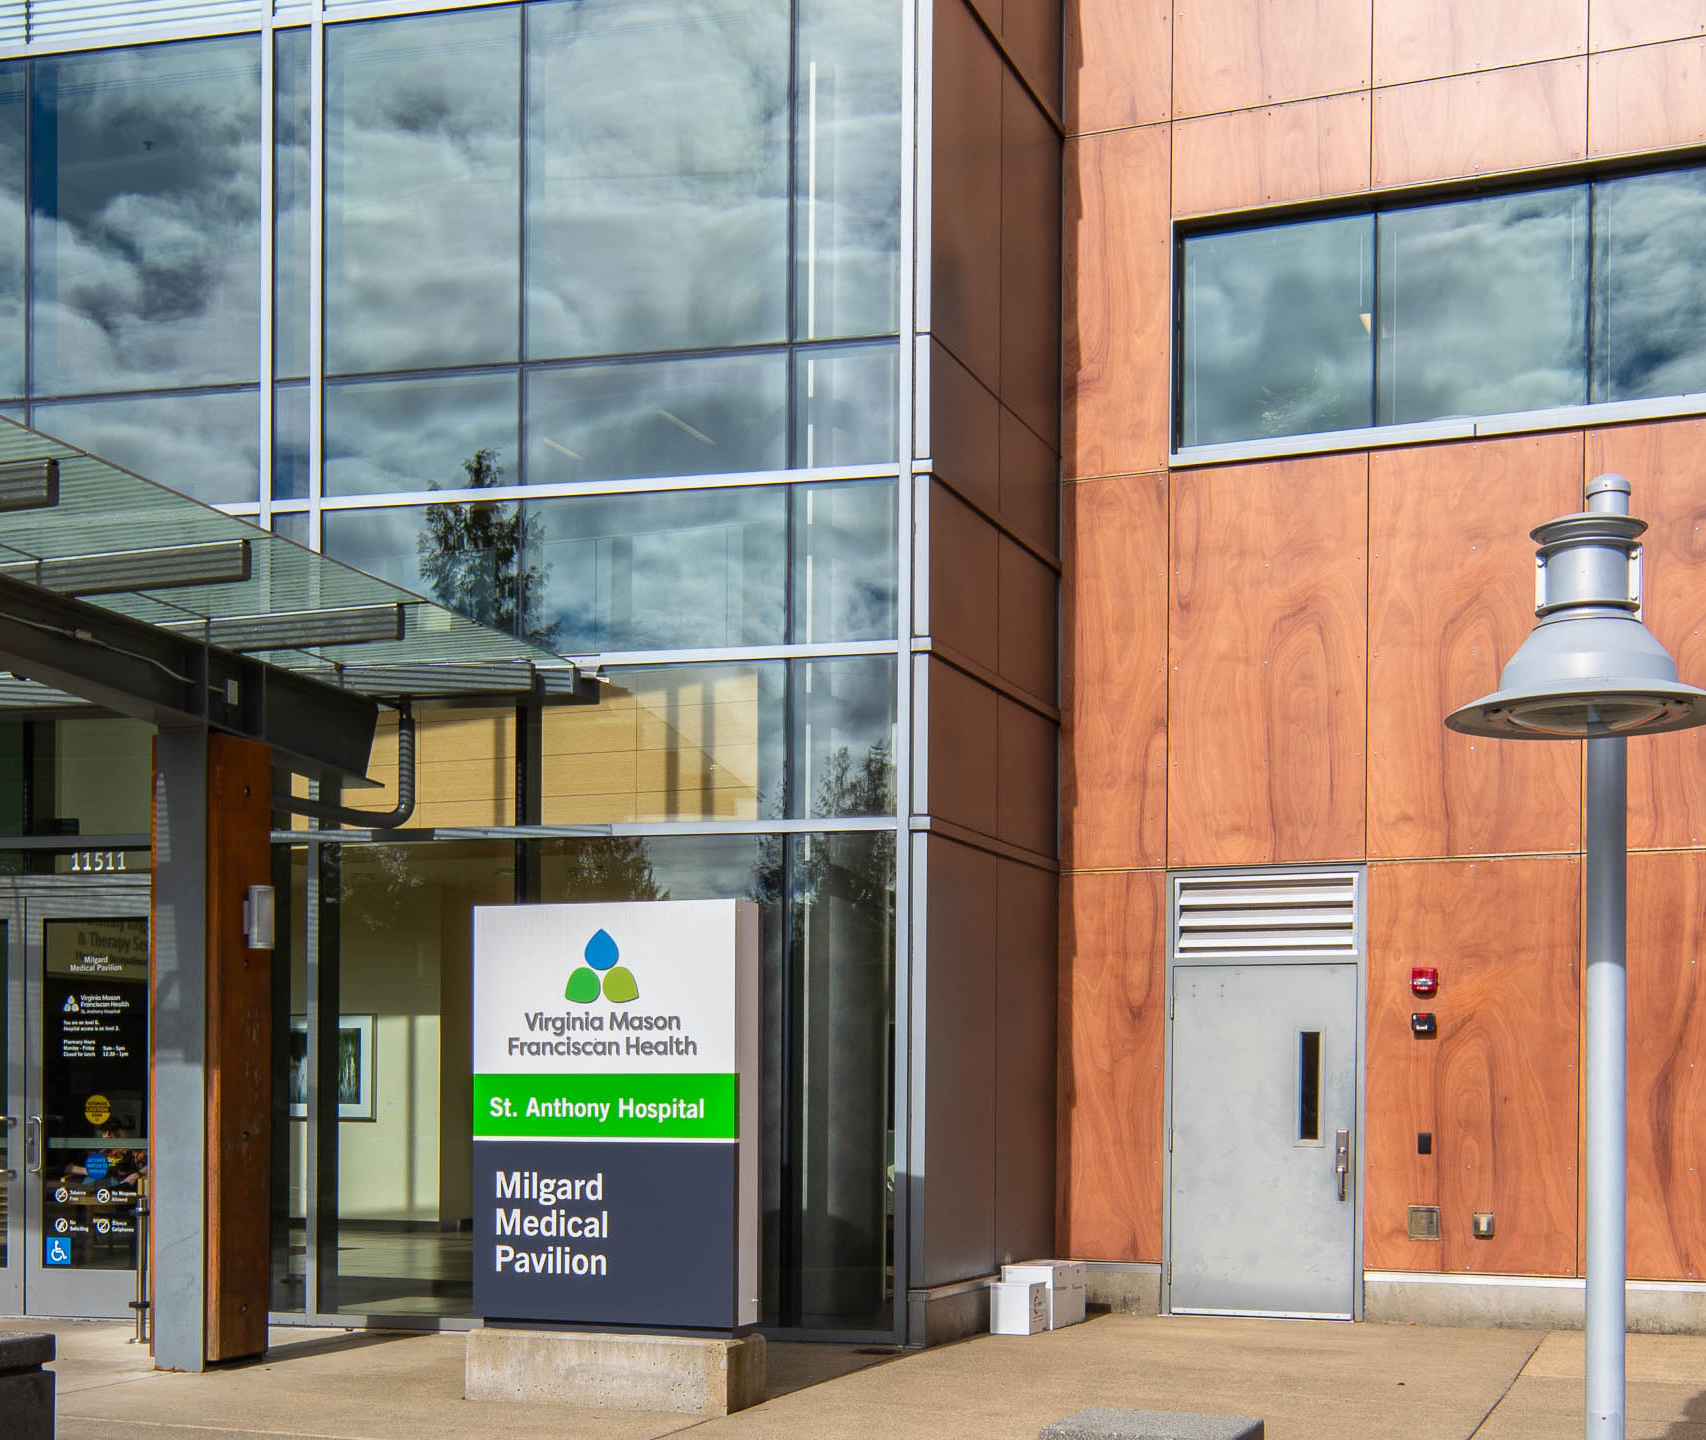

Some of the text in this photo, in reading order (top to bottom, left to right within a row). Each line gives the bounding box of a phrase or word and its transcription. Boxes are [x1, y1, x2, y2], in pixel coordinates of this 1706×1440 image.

[71, 852, 126, 871] 11511
[89, 931, 131, 953] Therapy
[69, 964, 123, 972] Medical Pavilion
[83, 956, 109, 964] Milgard
[524, 1011, 682, 1036] Virginia Mason
[507, 1035, 697, 1057] Franciscan Health
[489, 1096, 705, 1123] St. Anthony Hospital
[494, 1170, 604, 1206] Milgard
[494, 1207, 609, 1239] Medical
[494, 1244, 608, 1276] Pavilion
